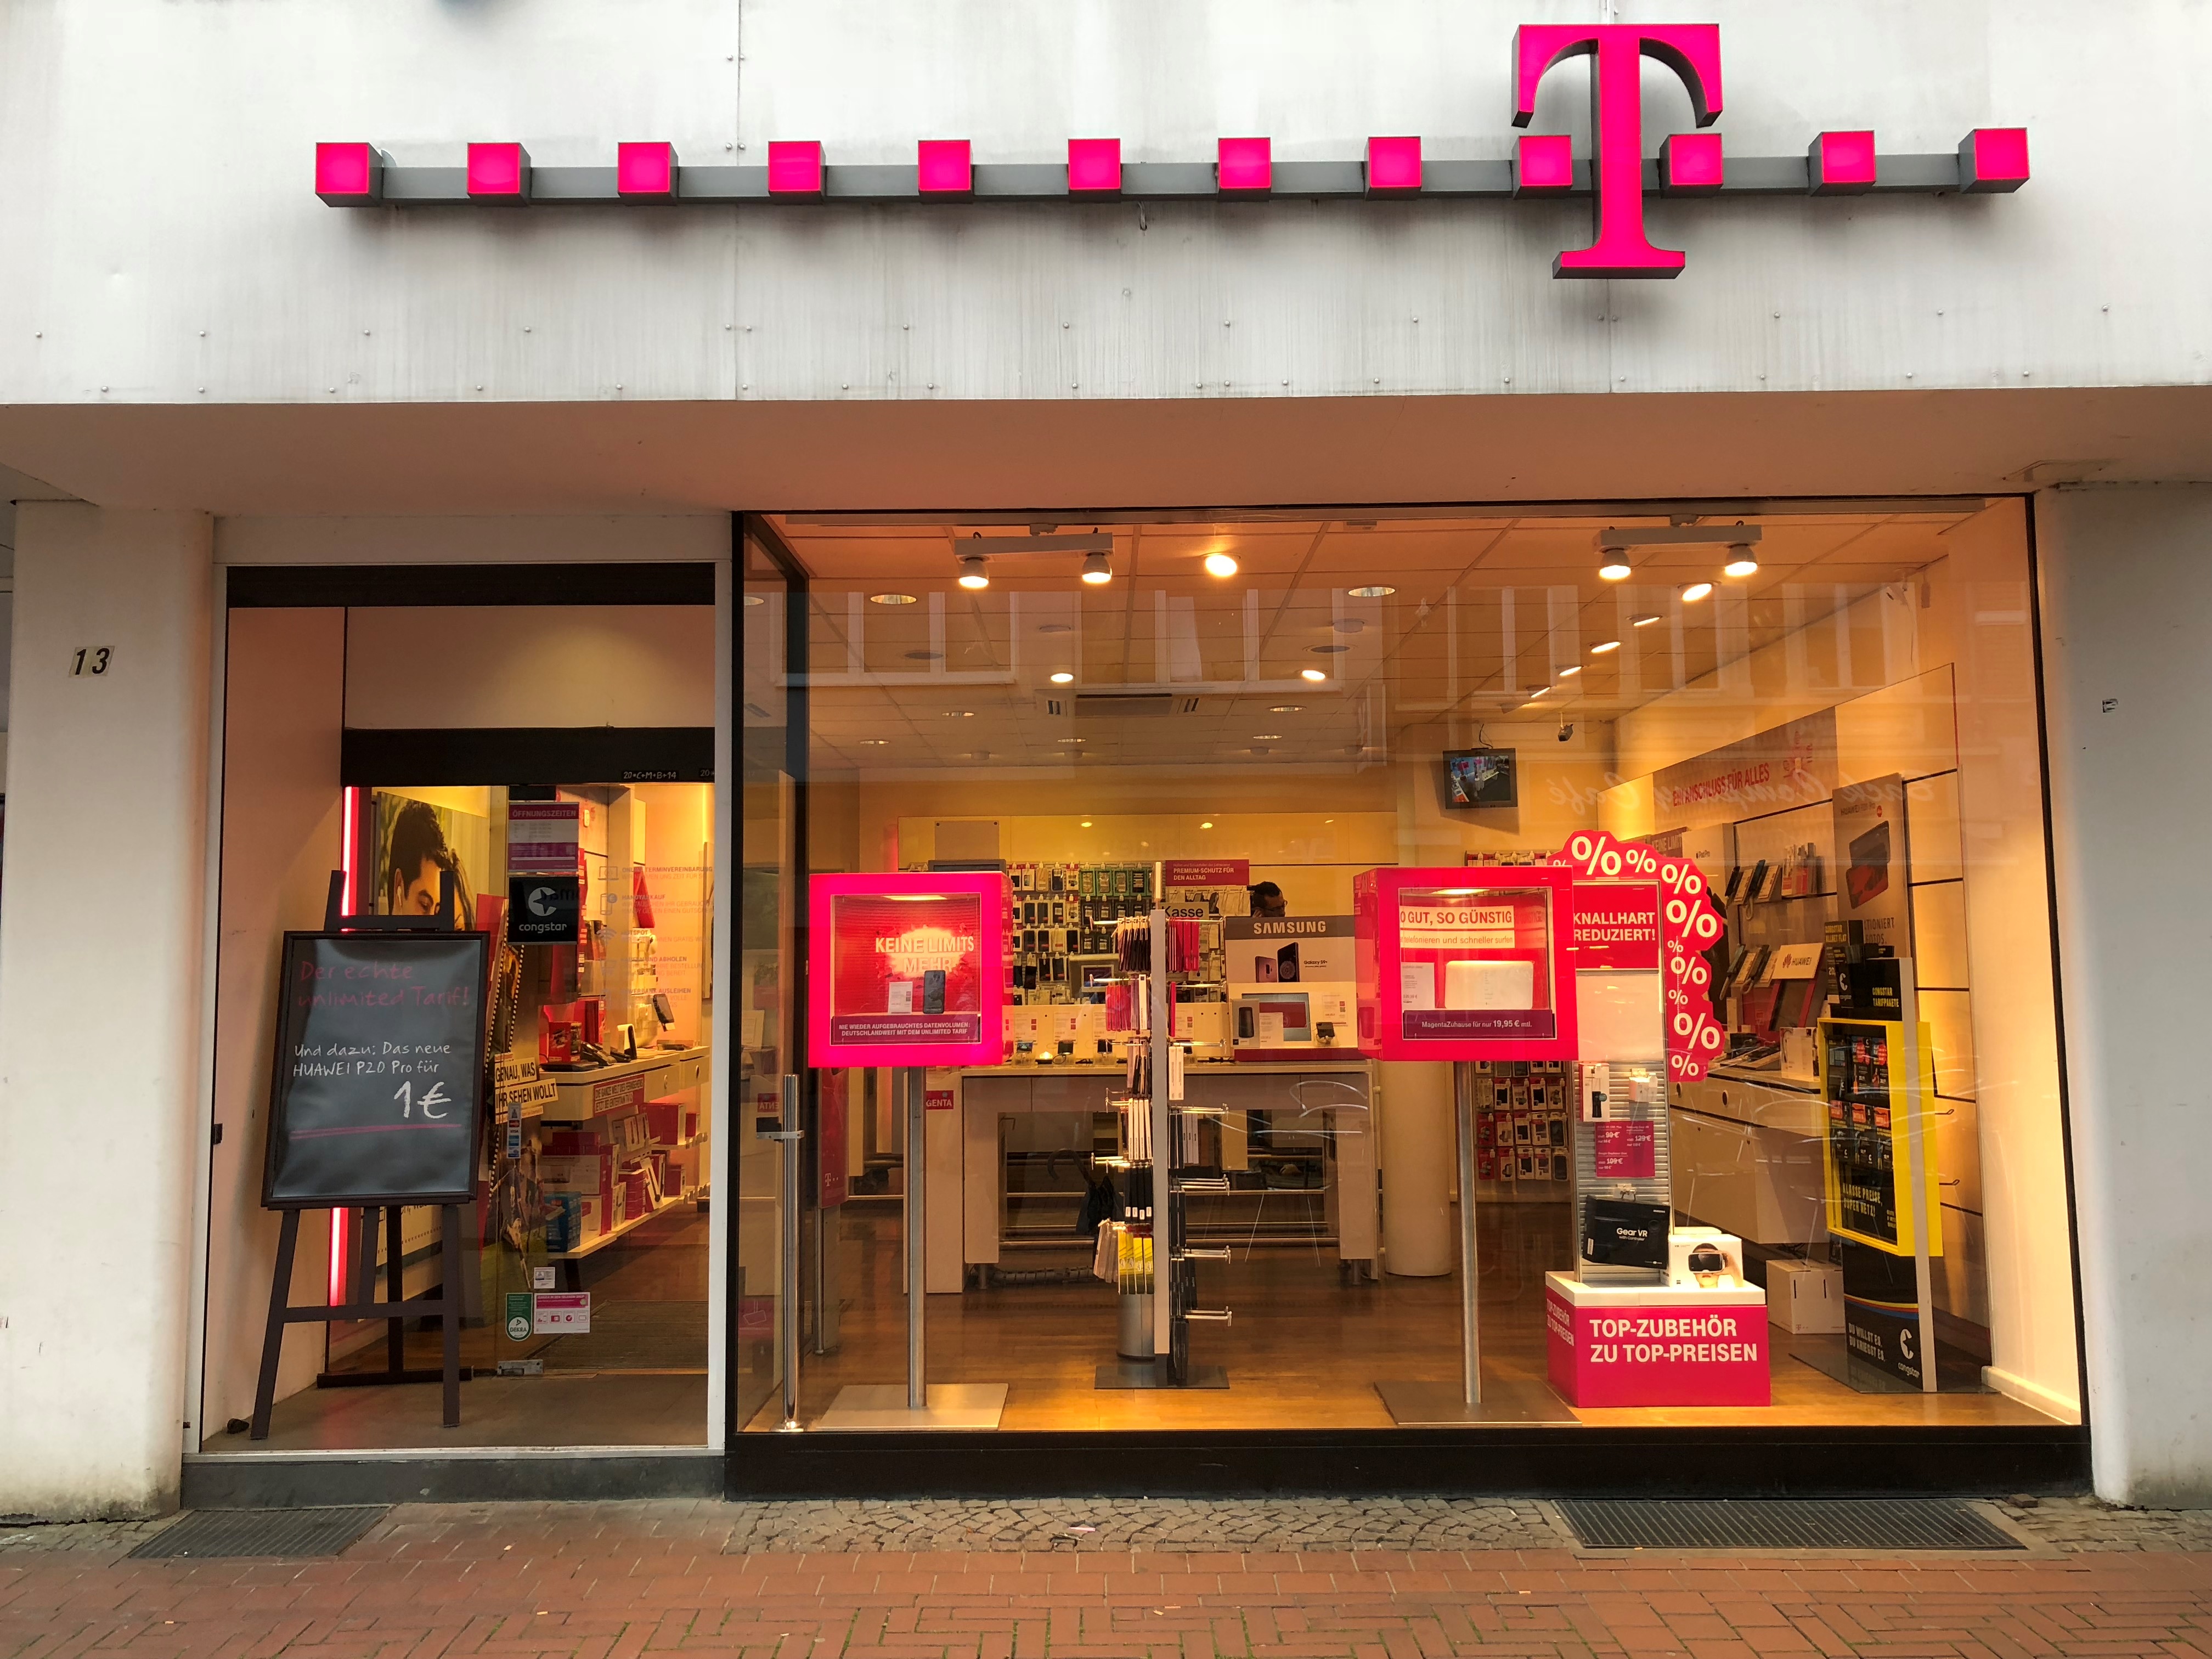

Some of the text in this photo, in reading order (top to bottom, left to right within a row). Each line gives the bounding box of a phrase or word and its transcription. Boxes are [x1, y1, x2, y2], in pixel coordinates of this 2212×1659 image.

[1511, 24, 1724, 279] T
[75, 648, 110, 675] 13
[1727, 769, 1743, 791] FÜR
[1745, 762, 1770, 786] ALLES
[1408, 911, 1432, 926] GUT,
[1436, 912, 1455, 924] SO
[1459, 910, 1512, 924] GÜNSTIG
[1573, 912, 1655, 924] KNALLHART
[518, 922, 567, 934] congstar
[1254, 921, 1326, 934] SAMSUNG
[1574, 928, 1656, 941] REDUZIERT!
[875, 935, 974, 953] KEINE LIMITS
[1495, 935, 1513, 944] surfen
[301, 961, 413, 981] Der echte
[903, 957, 952, 973] MEHR
[298, 986, 469, 1006] unlimited Tarif!
[1493, 1020, 1513, 1028] 19,95
[294, 1041, 452, 1058] Und dazu: Das neue
[293, 1060, 439, 1076] HUAWEI P20 Pro für
[495, 1062, 535, 1082] GENAU, WAS
[496, 1083, 556, 1108] IHR SEHEN WOLLT
[1616, 1227, 1648, 1237] Gear VR
[1589, 1314, 1737, 1338] TOP-ZUBEHÖR
[1590, 1343, 1757, 1362] ZU TOP-PREISEN
